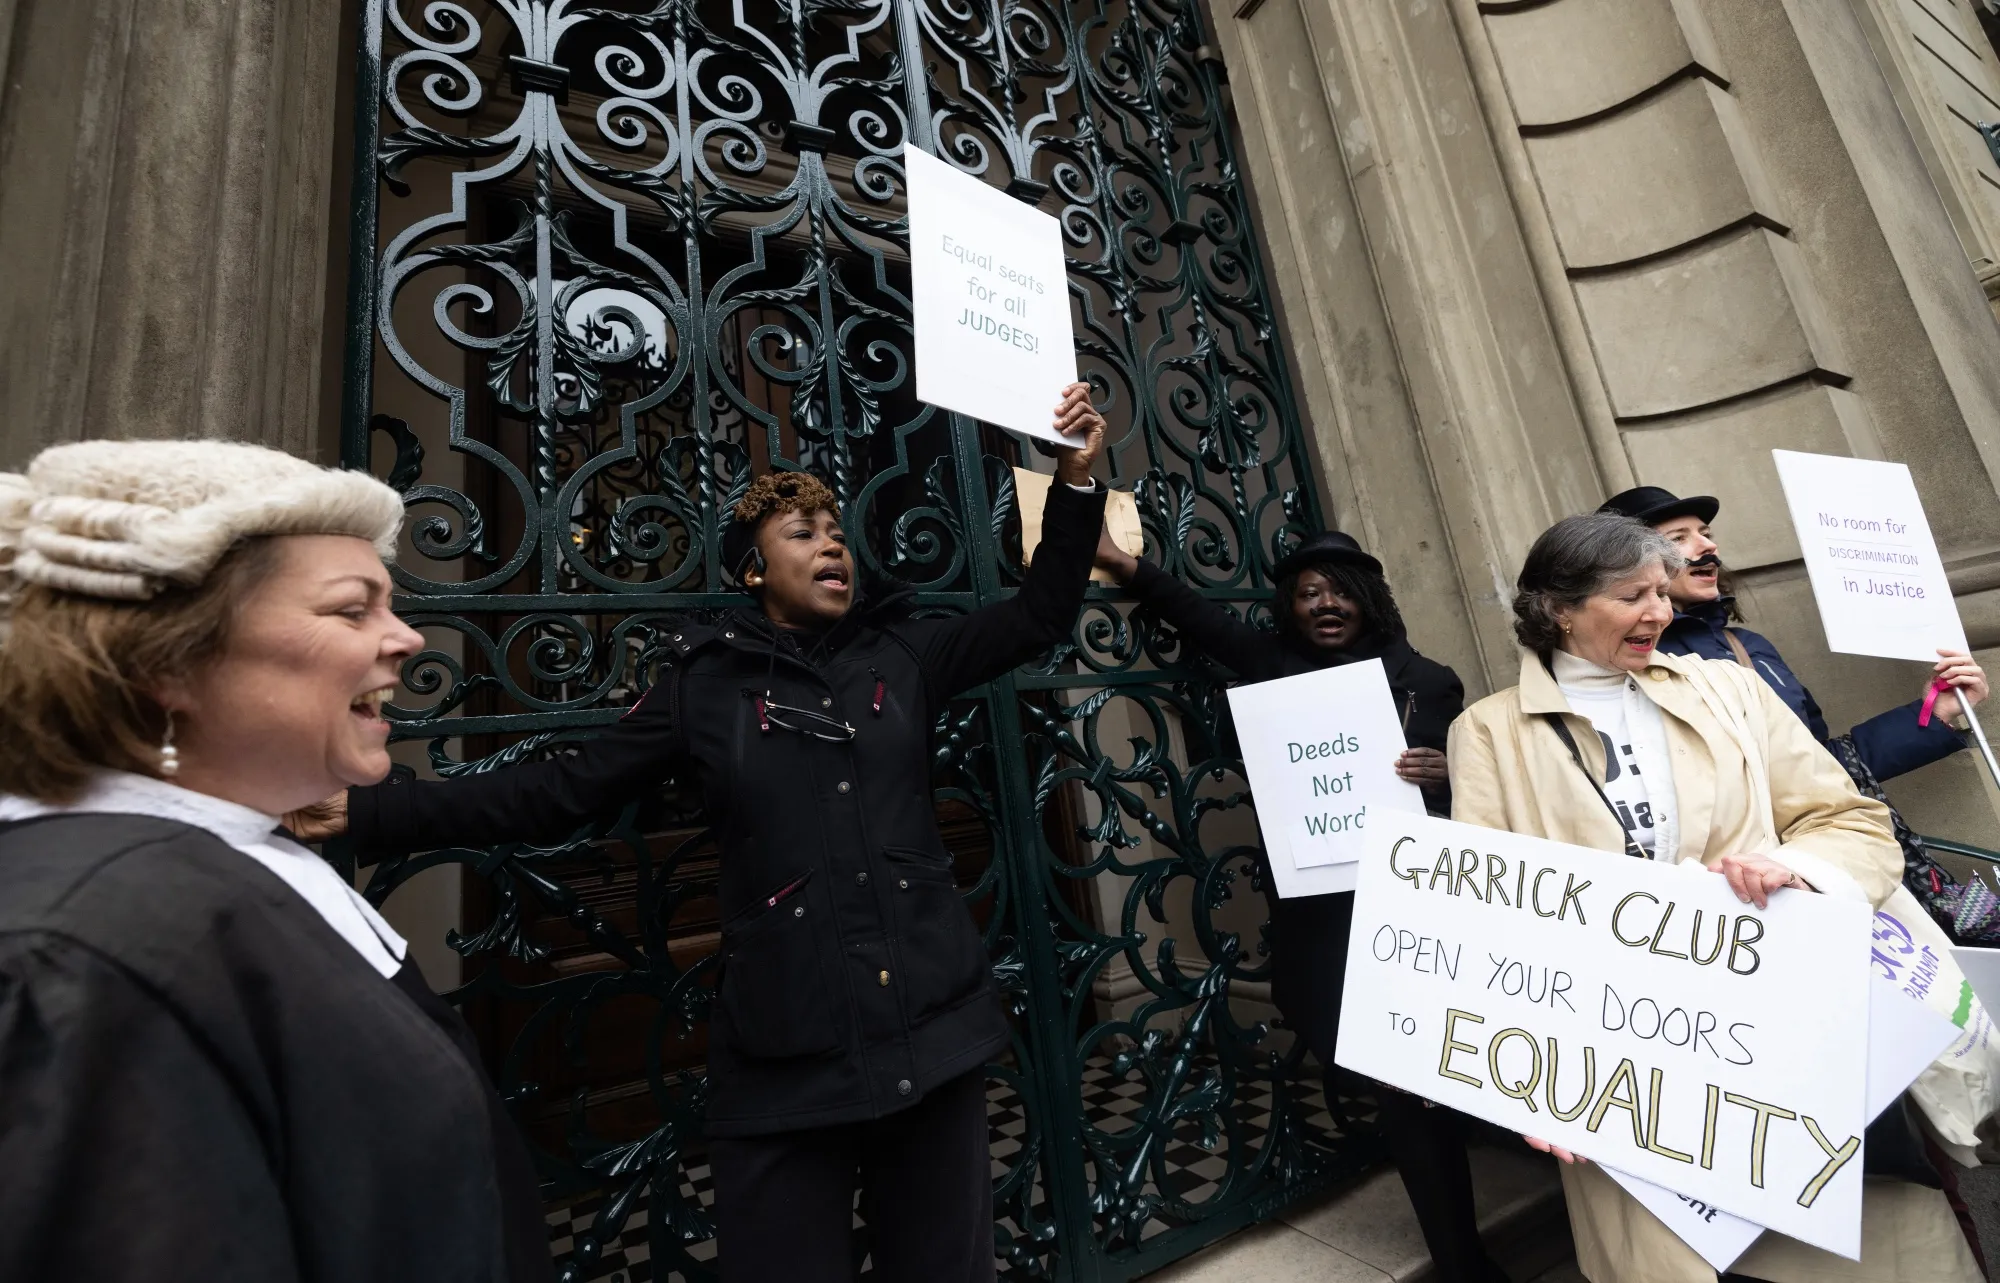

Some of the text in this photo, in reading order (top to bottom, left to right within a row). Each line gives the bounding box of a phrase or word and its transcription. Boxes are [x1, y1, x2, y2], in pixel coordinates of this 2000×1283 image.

[942, 234, 1044, 295] Equal seats
[967, 276, 1026, 318] for all
[958, 308, 1039, 354] JUDGES!
[1818, 511, 1907, 535] No room for
[1828, 546, 1919, 566] DISCRIMINATION
[1843, 576, 1925, 599] in Justice
[1287, 732, 1360, 763] Deeds
[1312, 771, 1354, 797] Not
[1304, 805, 1366, 836] Word
[1389, 836, 1765, 976] GARRICK CLUB
[1372, 924, 1756, 1066] OPEN YOUR DOORS
[1388, 1011, 1417, 1036] TO
[1437, 1007, 1862, 1209] EQUALITY
